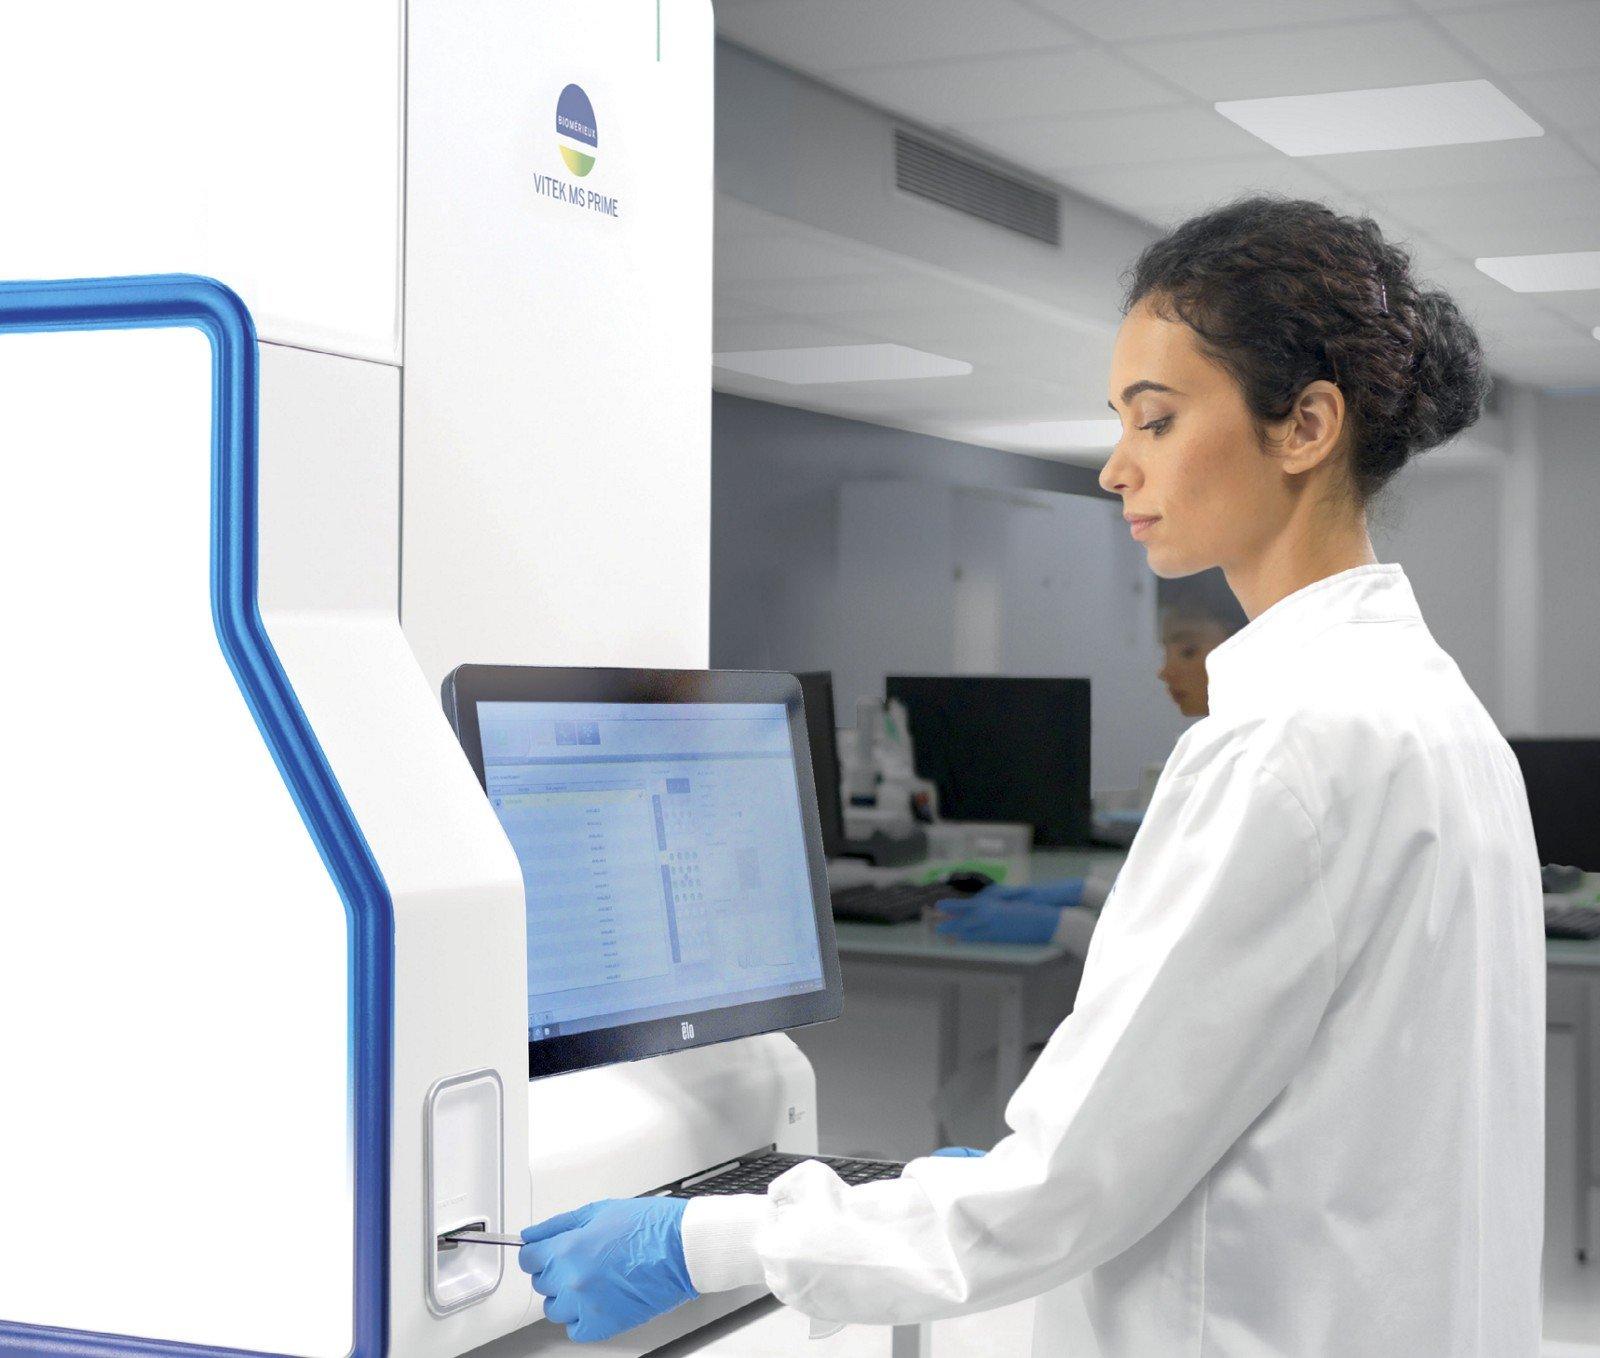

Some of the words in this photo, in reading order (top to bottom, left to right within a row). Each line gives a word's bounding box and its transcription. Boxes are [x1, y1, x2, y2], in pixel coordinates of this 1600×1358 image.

[534, 173, 566, 202] VITEK
[569, 184, 585, 207] MS
[588, 190, 619, 217] PRIME
